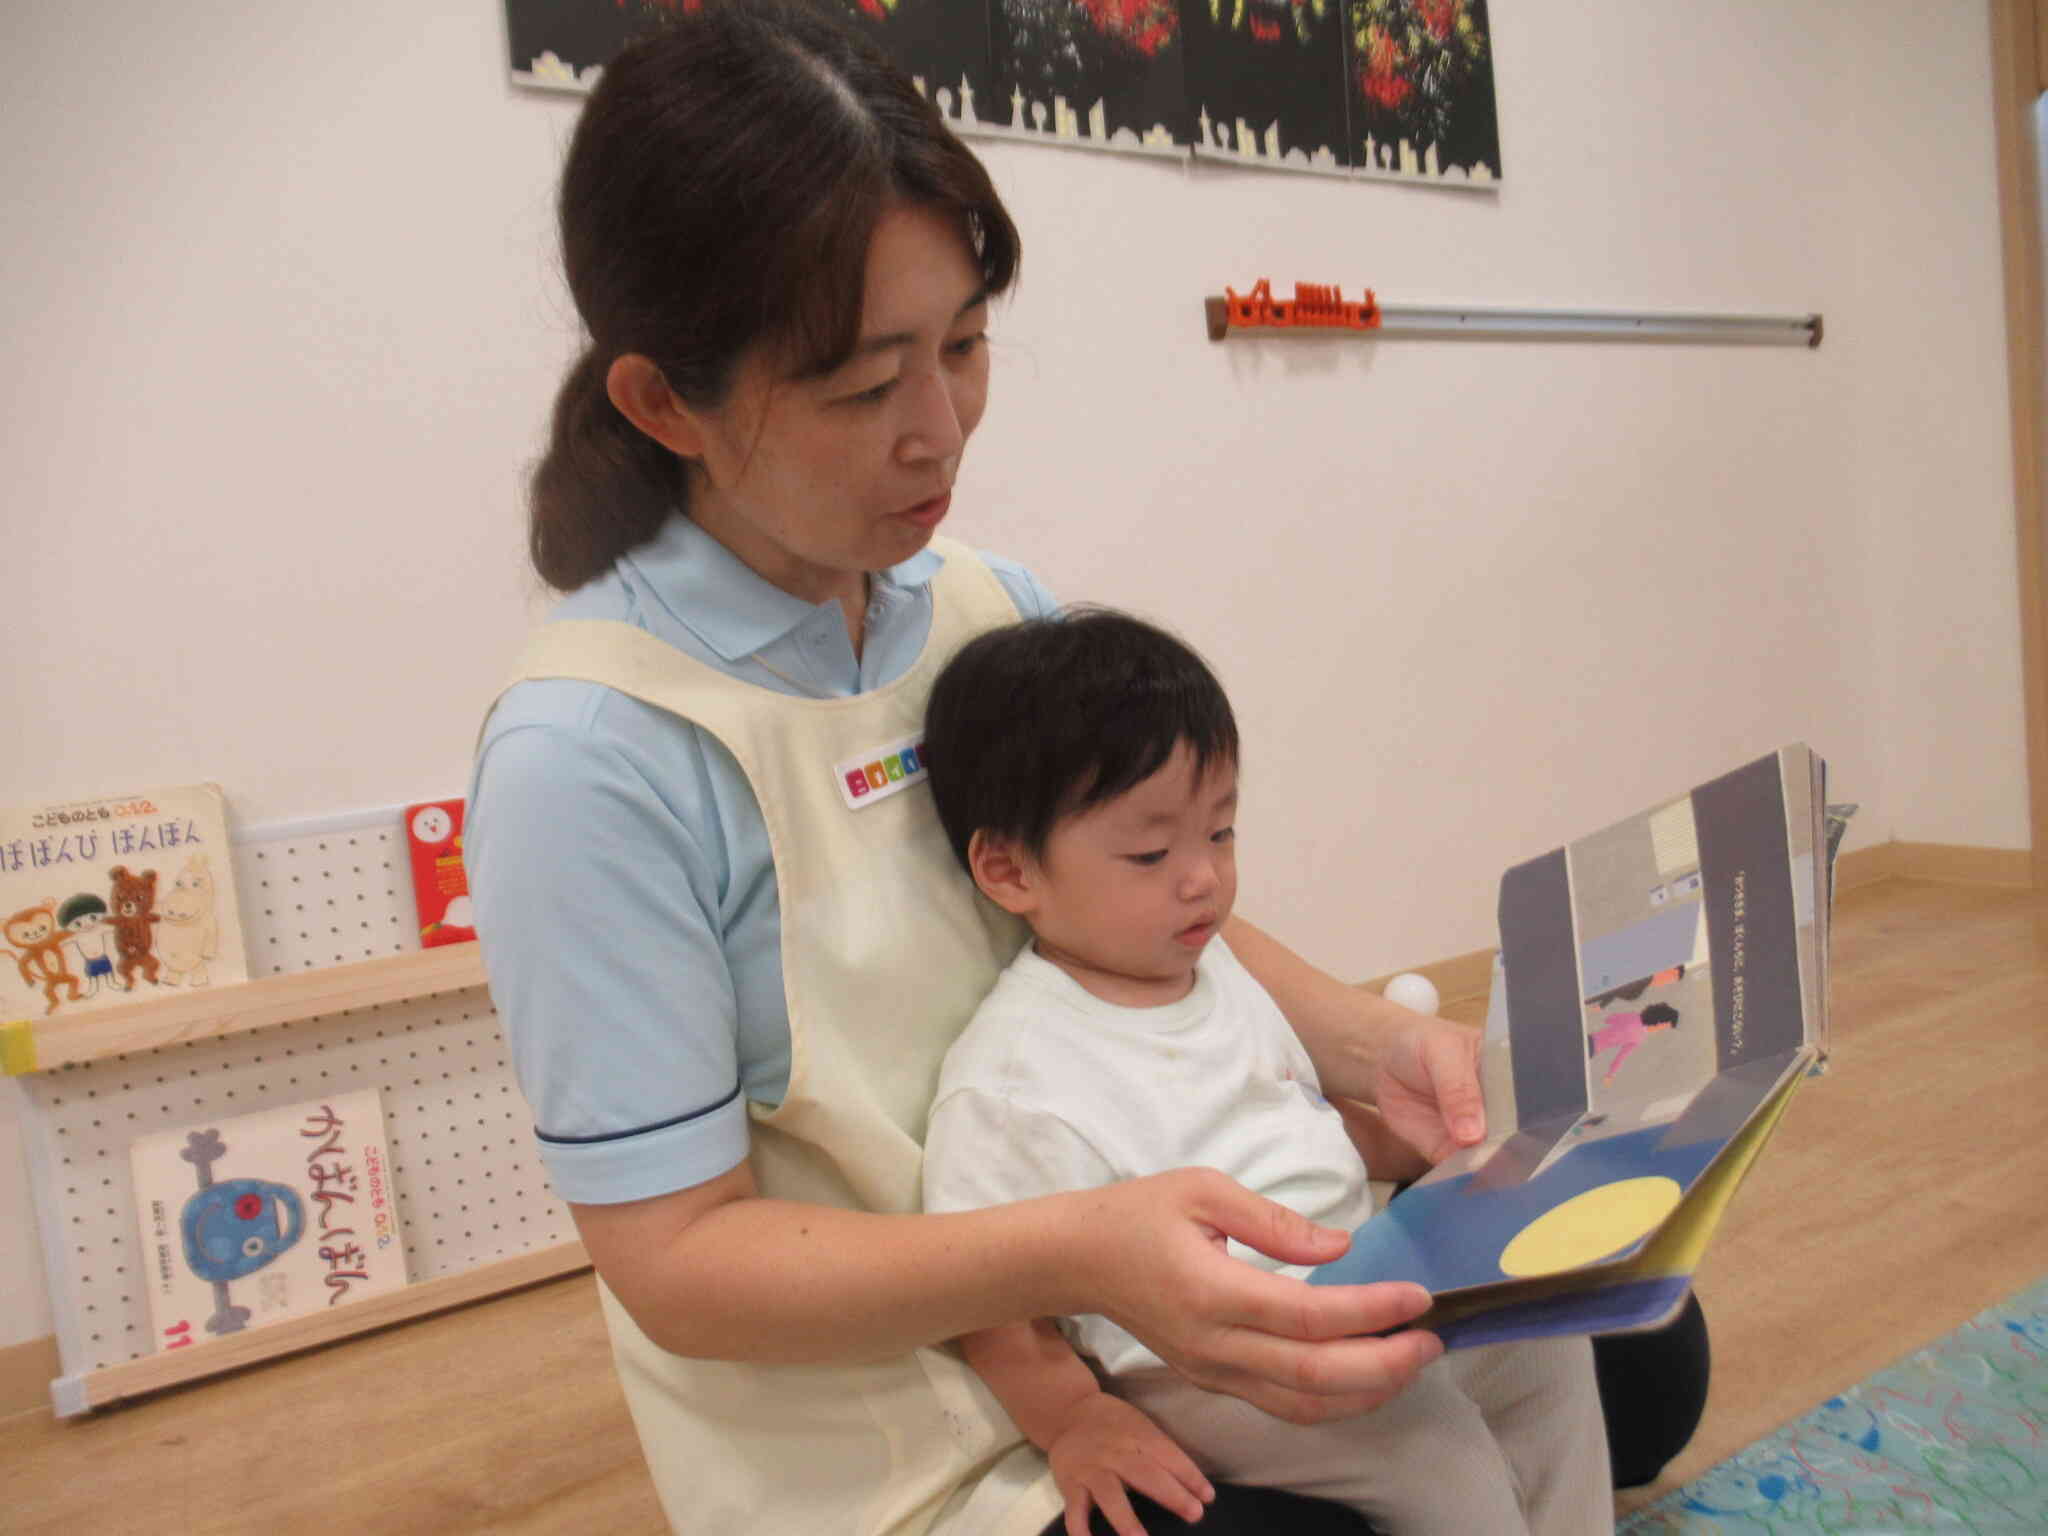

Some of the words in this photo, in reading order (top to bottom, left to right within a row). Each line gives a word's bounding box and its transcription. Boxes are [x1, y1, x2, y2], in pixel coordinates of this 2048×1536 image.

[300, 1104, 369, 1306] かばんばん
[164, 1319, 193, 1350] 11
